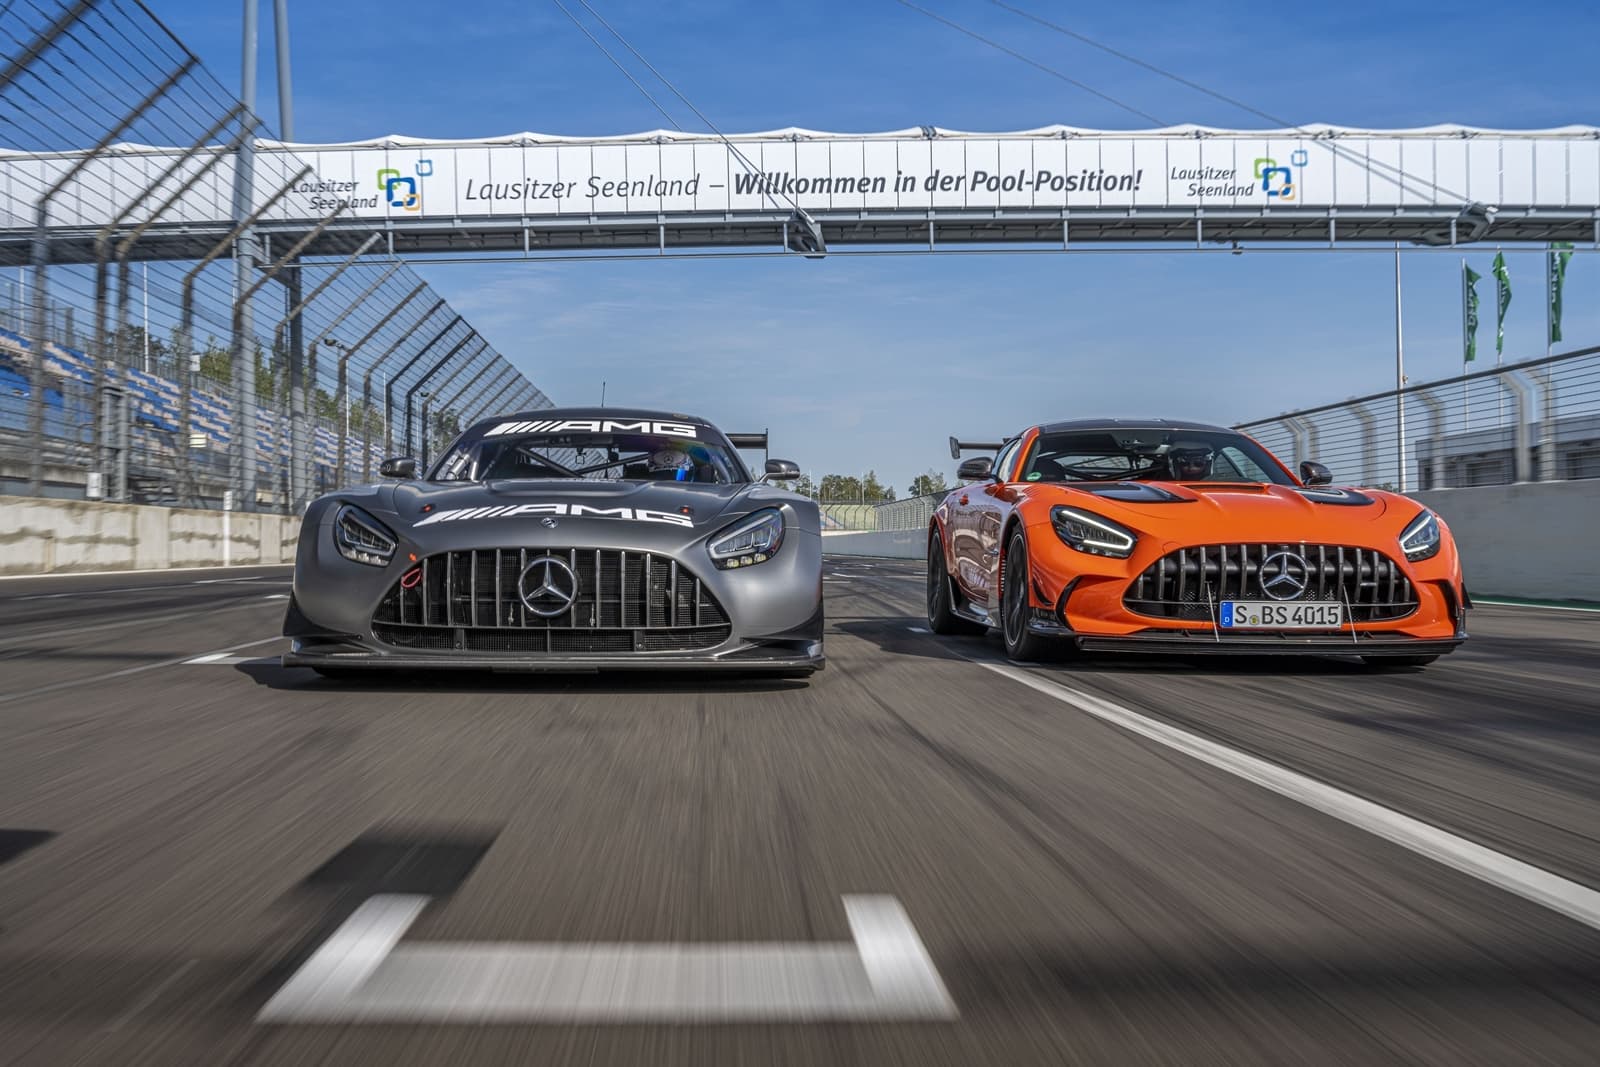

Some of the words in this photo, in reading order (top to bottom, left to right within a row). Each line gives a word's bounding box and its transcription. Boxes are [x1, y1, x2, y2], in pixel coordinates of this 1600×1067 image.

[1171, 166, 1236, 181] Lausitzer
[293, 179, 359, 193] Lausitzer
[465, 177, 577, 201] Lausitzer
[585, 173, 701, 199] Seenland
[735, 171, 886, 195] Willkommen
[894, 170, 917, 193] in
[924, 169, 966, 192] der
[970, 169, 1143, 193] Pool-Position!
[1187, 182, 1255, 198] Seenland
[549, 420, 697, 438] AMG
[500, 503, 694, 528] AMG
[1235, 605, 1247, 624] S
[1261, 605, 1288, 625] BS
[1292, 605, 1339, 625] 4015
